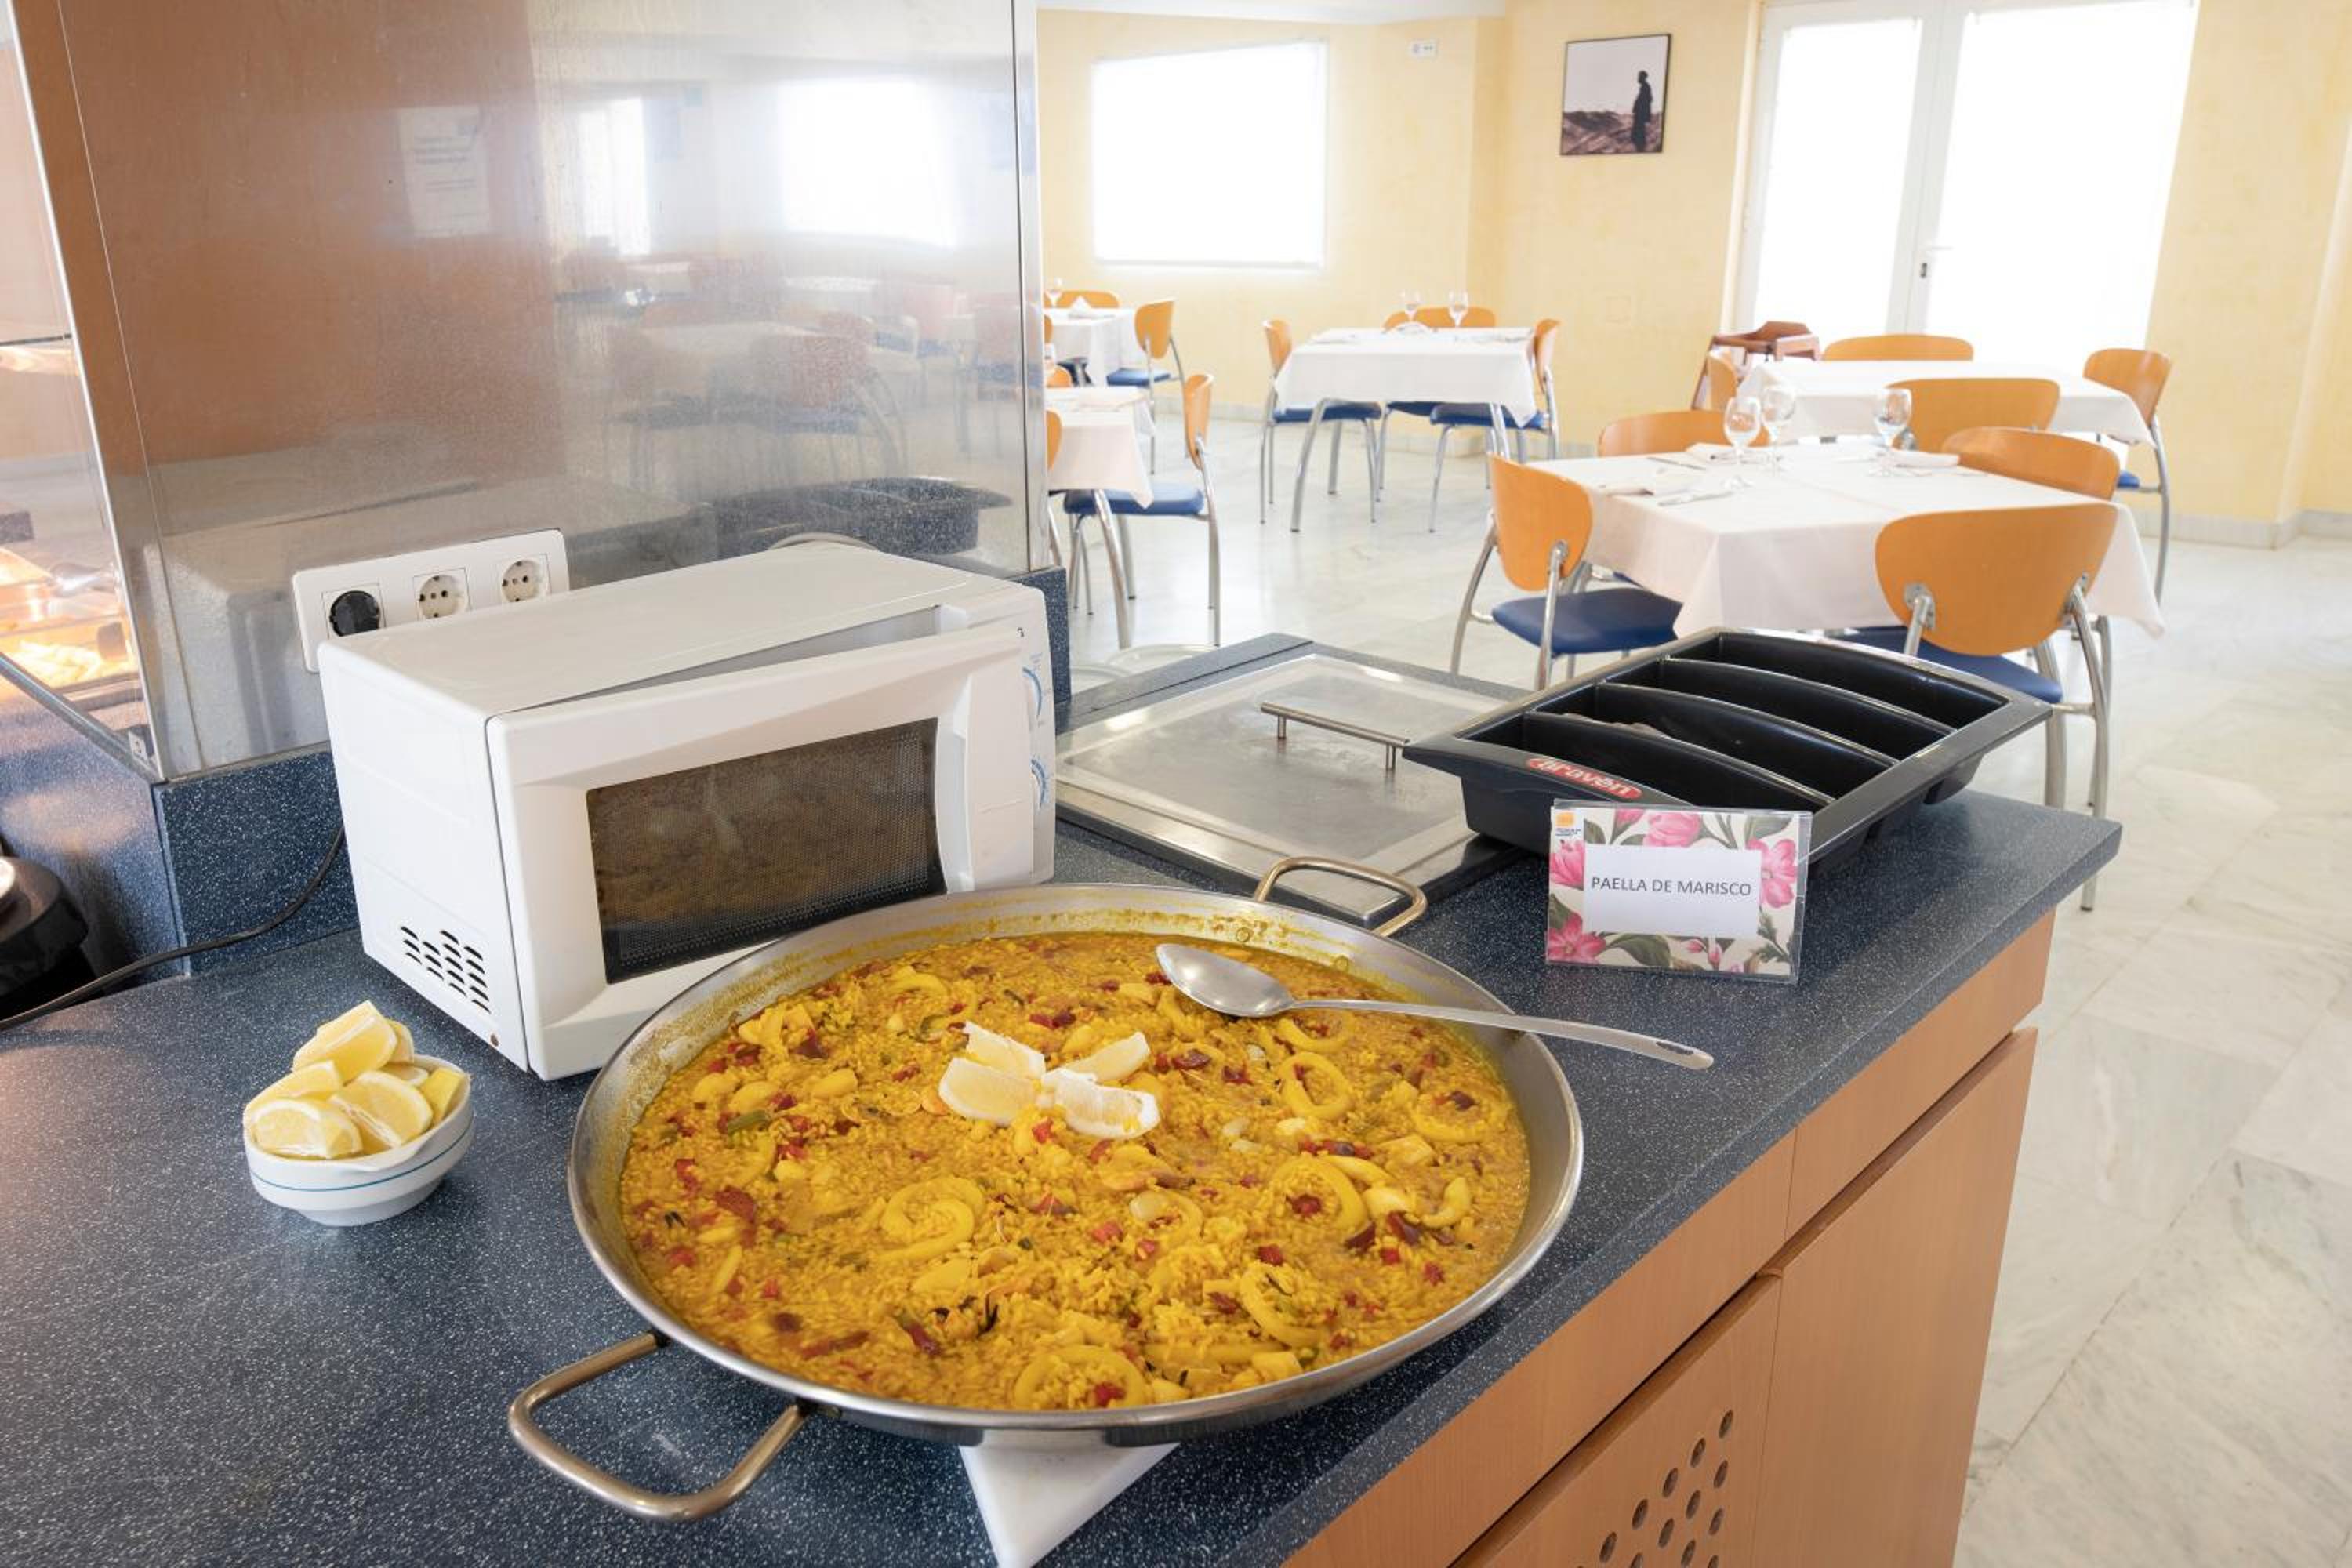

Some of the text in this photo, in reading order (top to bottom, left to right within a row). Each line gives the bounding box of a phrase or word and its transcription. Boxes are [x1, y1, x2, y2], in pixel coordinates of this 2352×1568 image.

[1591, 876, 1751, 896] PAELLA DE MARISCO
